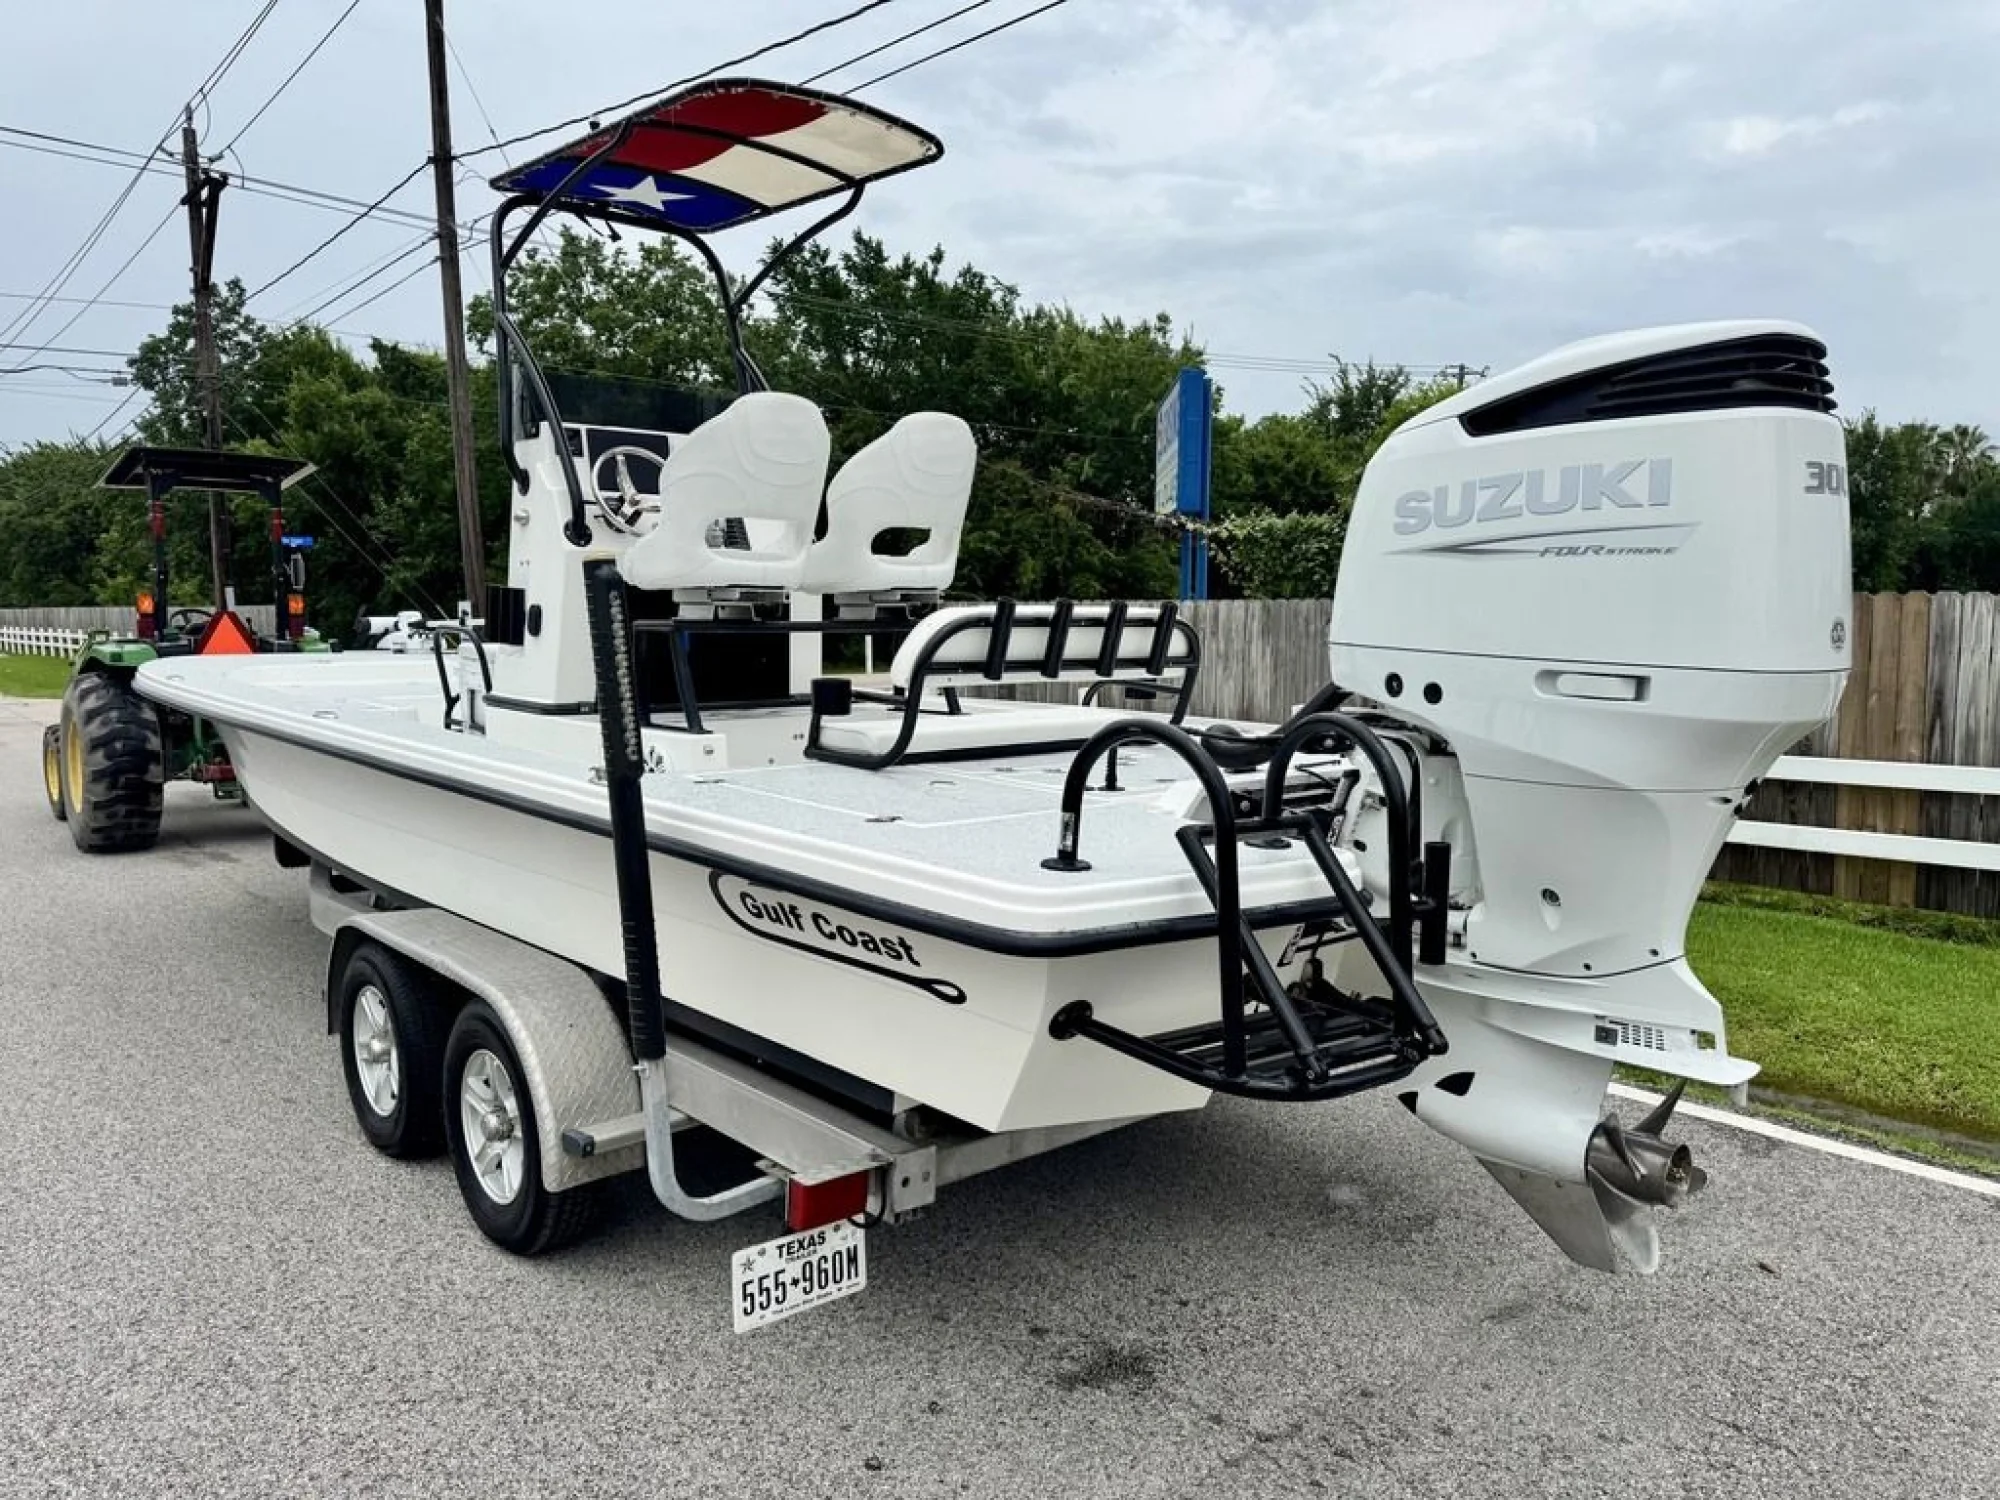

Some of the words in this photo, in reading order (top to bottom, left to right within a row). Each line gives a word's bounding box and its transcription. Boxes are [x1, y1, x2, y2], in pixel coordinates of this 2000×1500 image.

[1393, 457, 1673, 536] SUZUKI
[739, 891, 805, 932] Gulf
[811, 911, 922, 967] Coast
[775, 1230, 826, 1258] TEXAS
